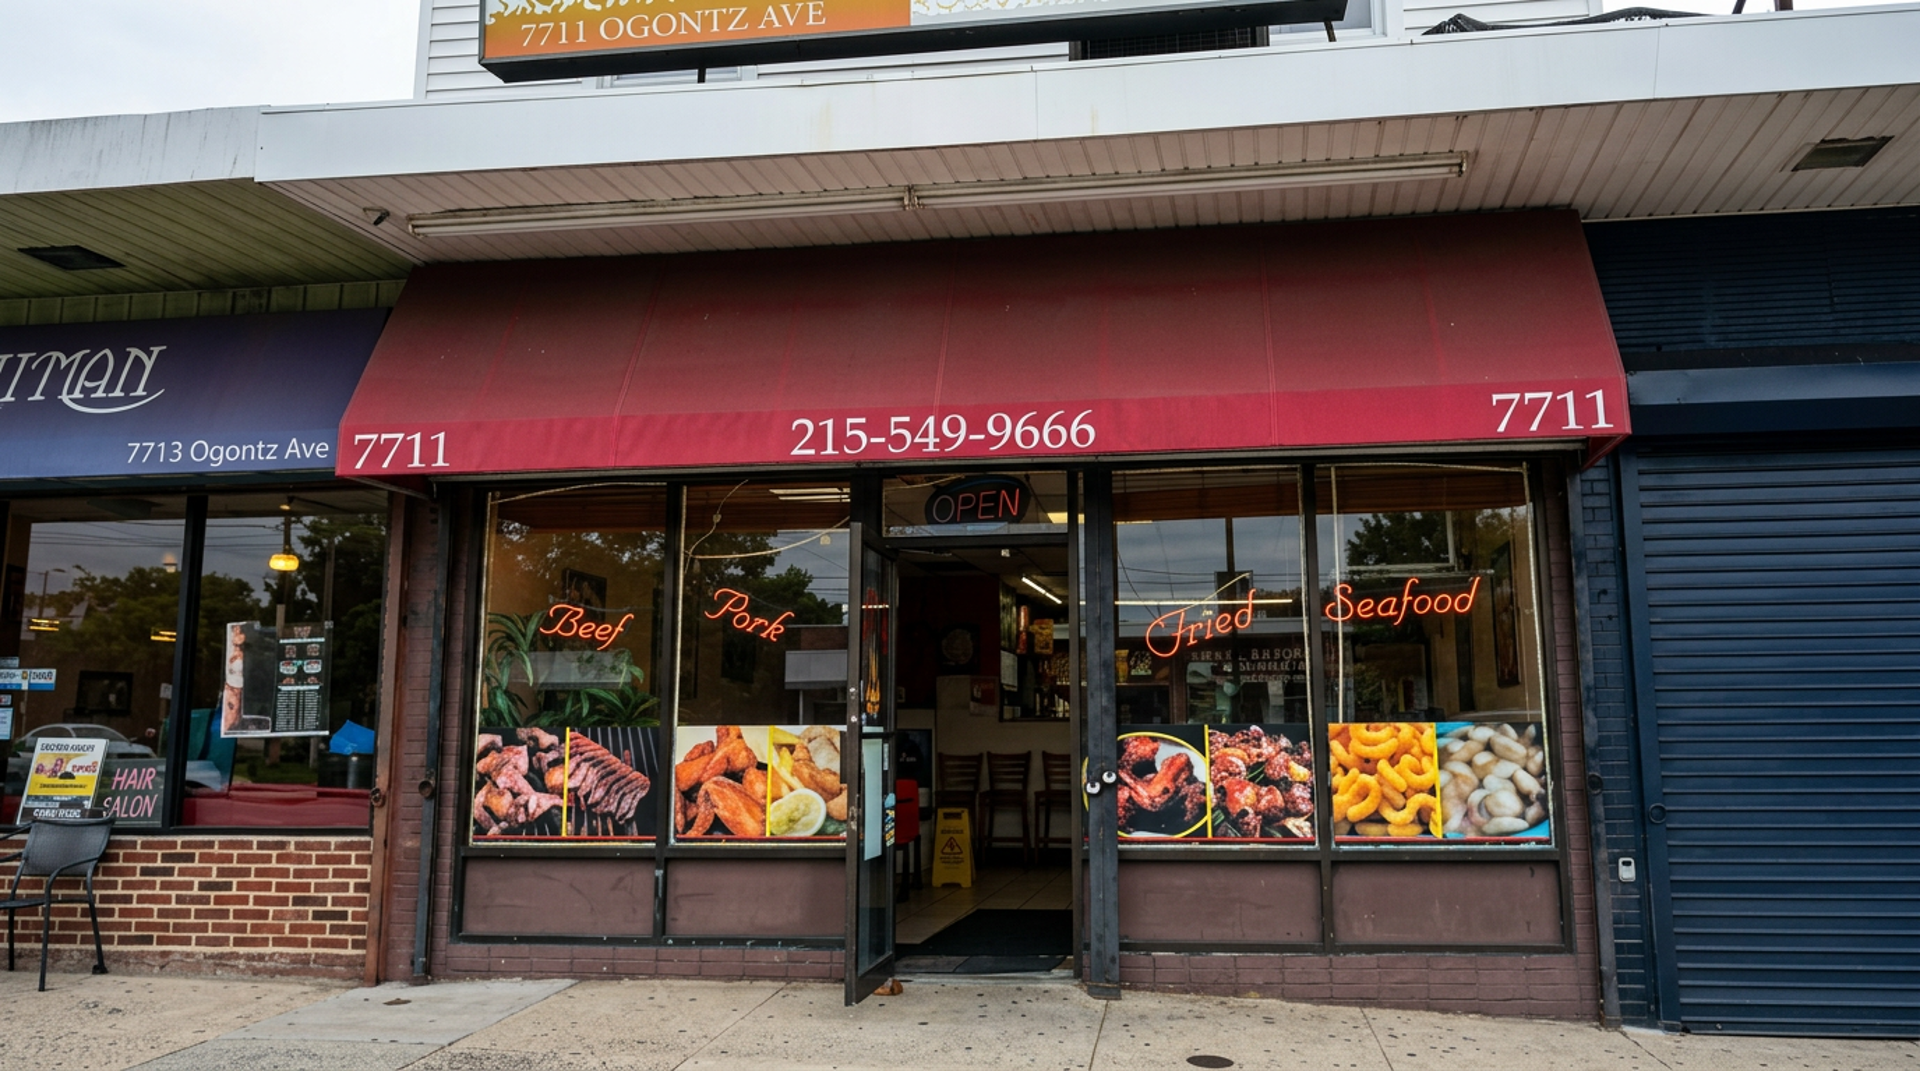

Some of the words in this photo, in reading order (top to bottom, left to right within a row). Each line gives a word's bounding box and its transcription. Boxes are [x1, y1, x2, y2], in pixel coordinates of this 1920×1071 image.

[520, 20, 587, 48] 7711
[599, 7, 749, 41] OGONTZ
[757, 1, 827, 30] AVE
[790, 409, 1096, 456] 215-549-9666
[1491, 389, 1614, 432] 7711
[127, 441, 183, 463] 7713
[190, 440, 279, 467] Ogontz
[284, 437, 330, 460] Ave
[354, 431, 450, 469] 7711
[932, 488, 1020, 523] OPEN
[704, 587, 795, 642] Pork
[1145, 588, 1257, 658] Fried
[1324, 576, 1481, 626] Seafood
[539, 604, 635, 650] Beef
[111, 767, 157, 790] HAIR
[102, 794, 158, 818] SALON
